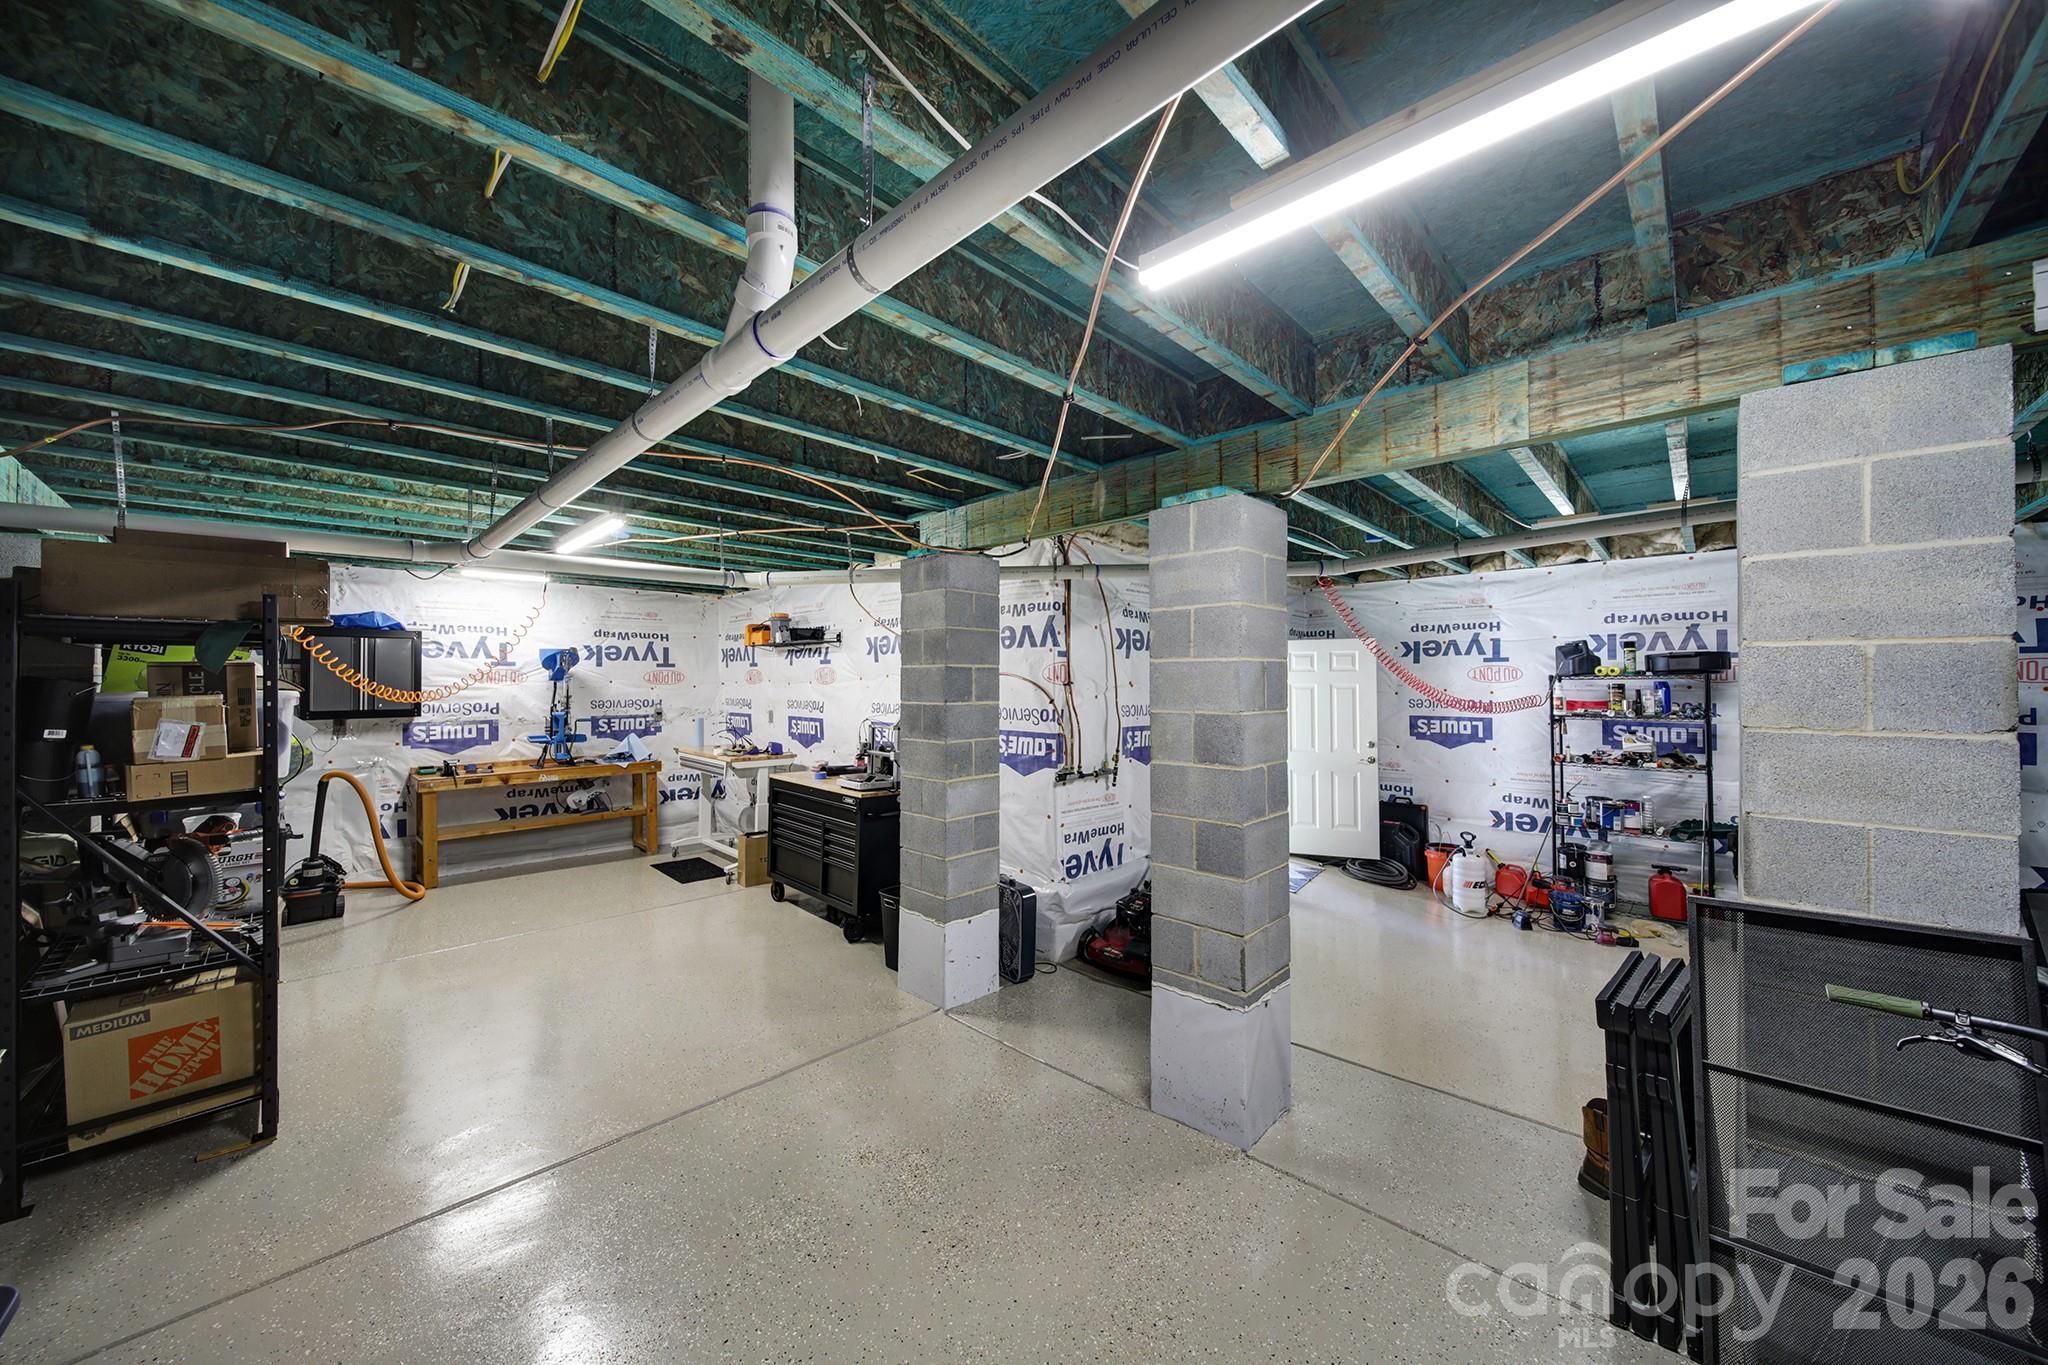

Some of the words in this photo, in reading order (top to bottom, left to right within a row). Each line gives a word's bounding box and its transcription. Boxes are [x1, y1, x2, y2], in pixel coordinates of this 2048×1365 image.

[1126, 7, 1177, 52] CELLULAR
[1097, 50, 1121, 74] CORE
[1029, 103, 1050, 125] PIPE
[981, 136, 1008, 161] SCH-40
[1410, 621, 1500, 634] HomeWrap
[1603, 610, 1728, 625] HomeWrap
[594, 629, 669, 642] HomeWrap
[122, 643, 165, 654] RYOBI
[583, 641, 676, 668] Tyvek
[1401, 632, 1509, 664] Tyvek
[1470, 667, 1499, 682] PONT
[590, 699, 663, 711] ProServices
[787, 700, 824, 713] ProServices
[412, 722, 490, 743] LOWE'S
[791, 719, 821, 738] LOWE'S
[1417, 718, 1484, 736] LOWE'S
[1000, 734, 1057, 762] LOWE'S
[76, 1012, 146, 1038] MEDIUM
[131, 1020, 221, 1096] HOME
[138, 1035, 177, 1066] THE
[165, 1038, 221, 1089] DEPOT
